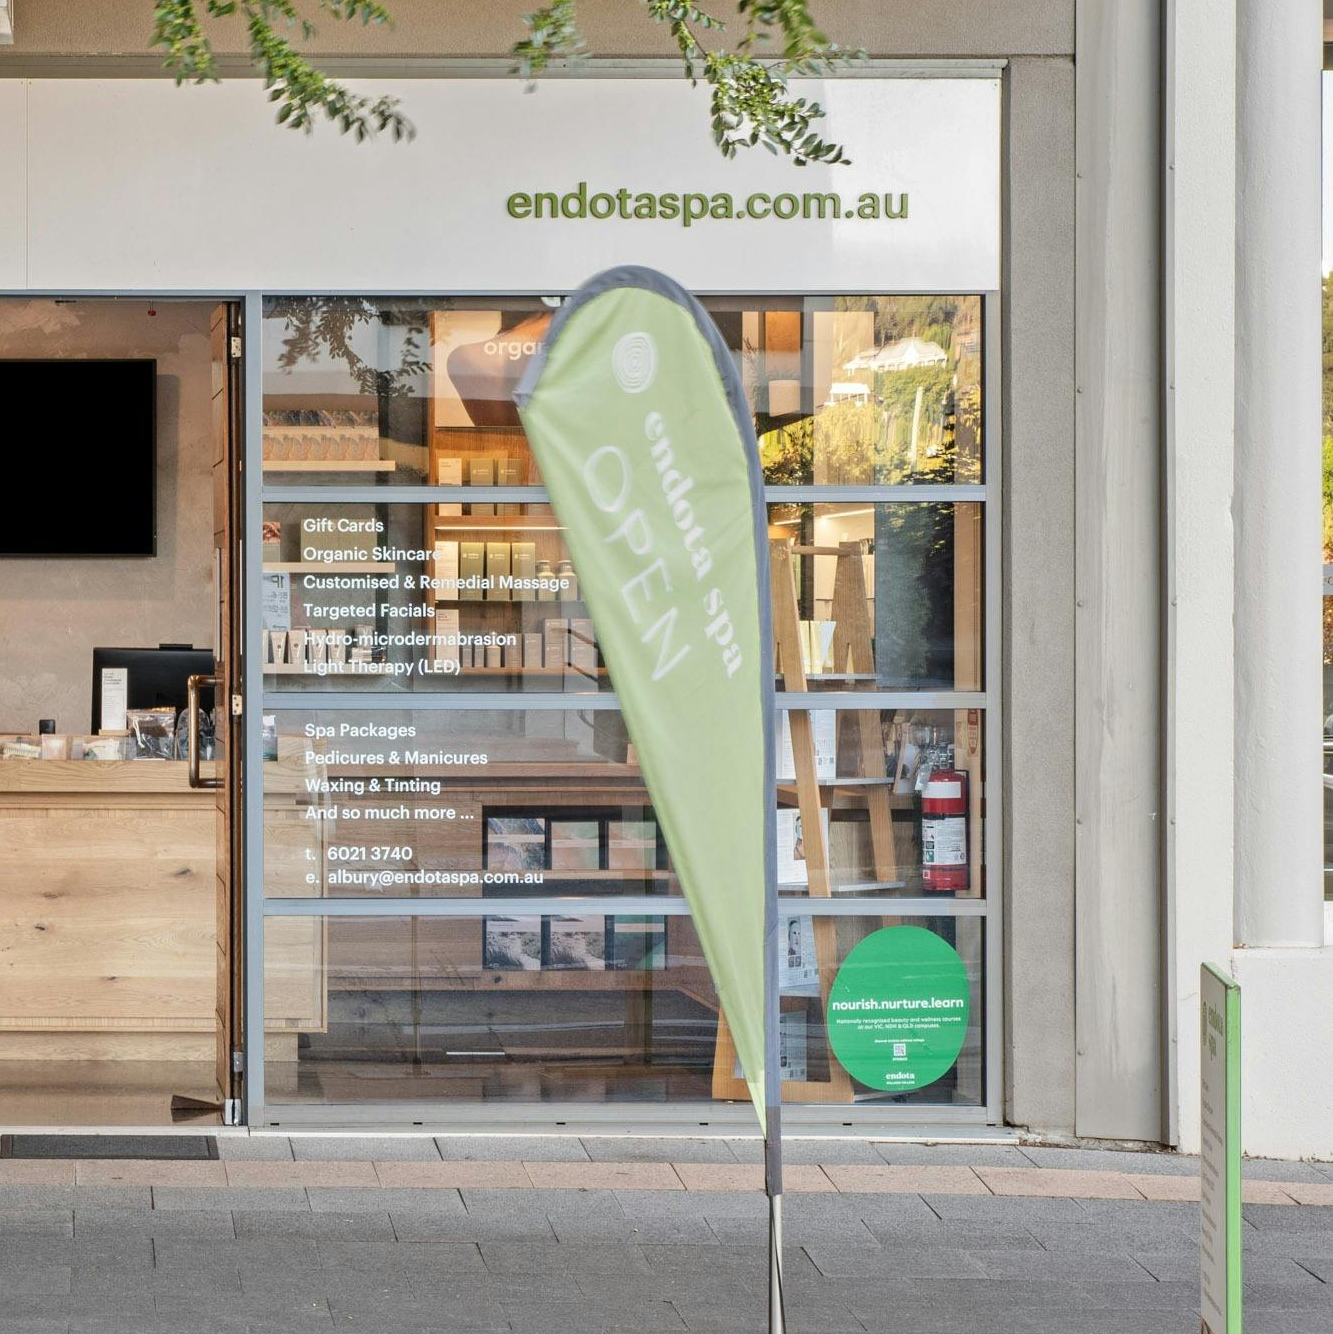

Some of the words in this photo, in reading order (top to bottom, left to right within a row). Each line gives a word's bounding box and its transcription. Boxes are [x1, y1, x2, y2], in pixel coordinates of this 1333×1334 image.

[506, 181, 909, 227] endotaspa.com.au
[303, 518, 333, 533] Gift
[337, 518, 384, 533] Cards
[644, 411, 713, 582] endota
[703, 587, 743, 678] spa
[303, 546, 369, 563] Organic
[372, 546, 442, 561] Skincare
[583, 445, 692, 682] OPEN
[303, 575, 400, 589] Customised
[403, 575, 416, 589] &
[420, 574, 495, 589] Remedial
[499, 575, 570, 593] Massage
[303, 603, 376, 620] Targeted
[380, 602, 436, 618] Facials
[303, 630, 517, 649] Hydro-microdermabrasion
[303, 659, 344, 676] Light
[347, 659, 414, 676] Therapy
[418, 659, 462, 676] (LED)
[305, 723, 336, 740] Spa
[340, 723, 416, 739] Packages
[305, 750, 385, 765] Pedicures
[388, 751, 401, 765] &
[404, 750, 488, 765] Manicures
[305, 778, 365, 795] Waxing
[368, 778, 381, 792] &
[384, 778, 441, 795] Tinting
[305, 805, 338, 820] And
[342, 808, 360, 820] so
[364, 805, 411, 820] much
[415, 808, 456, 820] more
[305, 847, 316, 860] t.
[327, 847, 367, 861] 6021
[370, 847, 413, 861] 3740
[305, 872, 319, 884] e.
[328, 869, 544, 886] albury@endotaspa.com.au
[832, 997, 964, 1011] nourish.nurture.learn
[885, 1071, 915, 1080] endota
